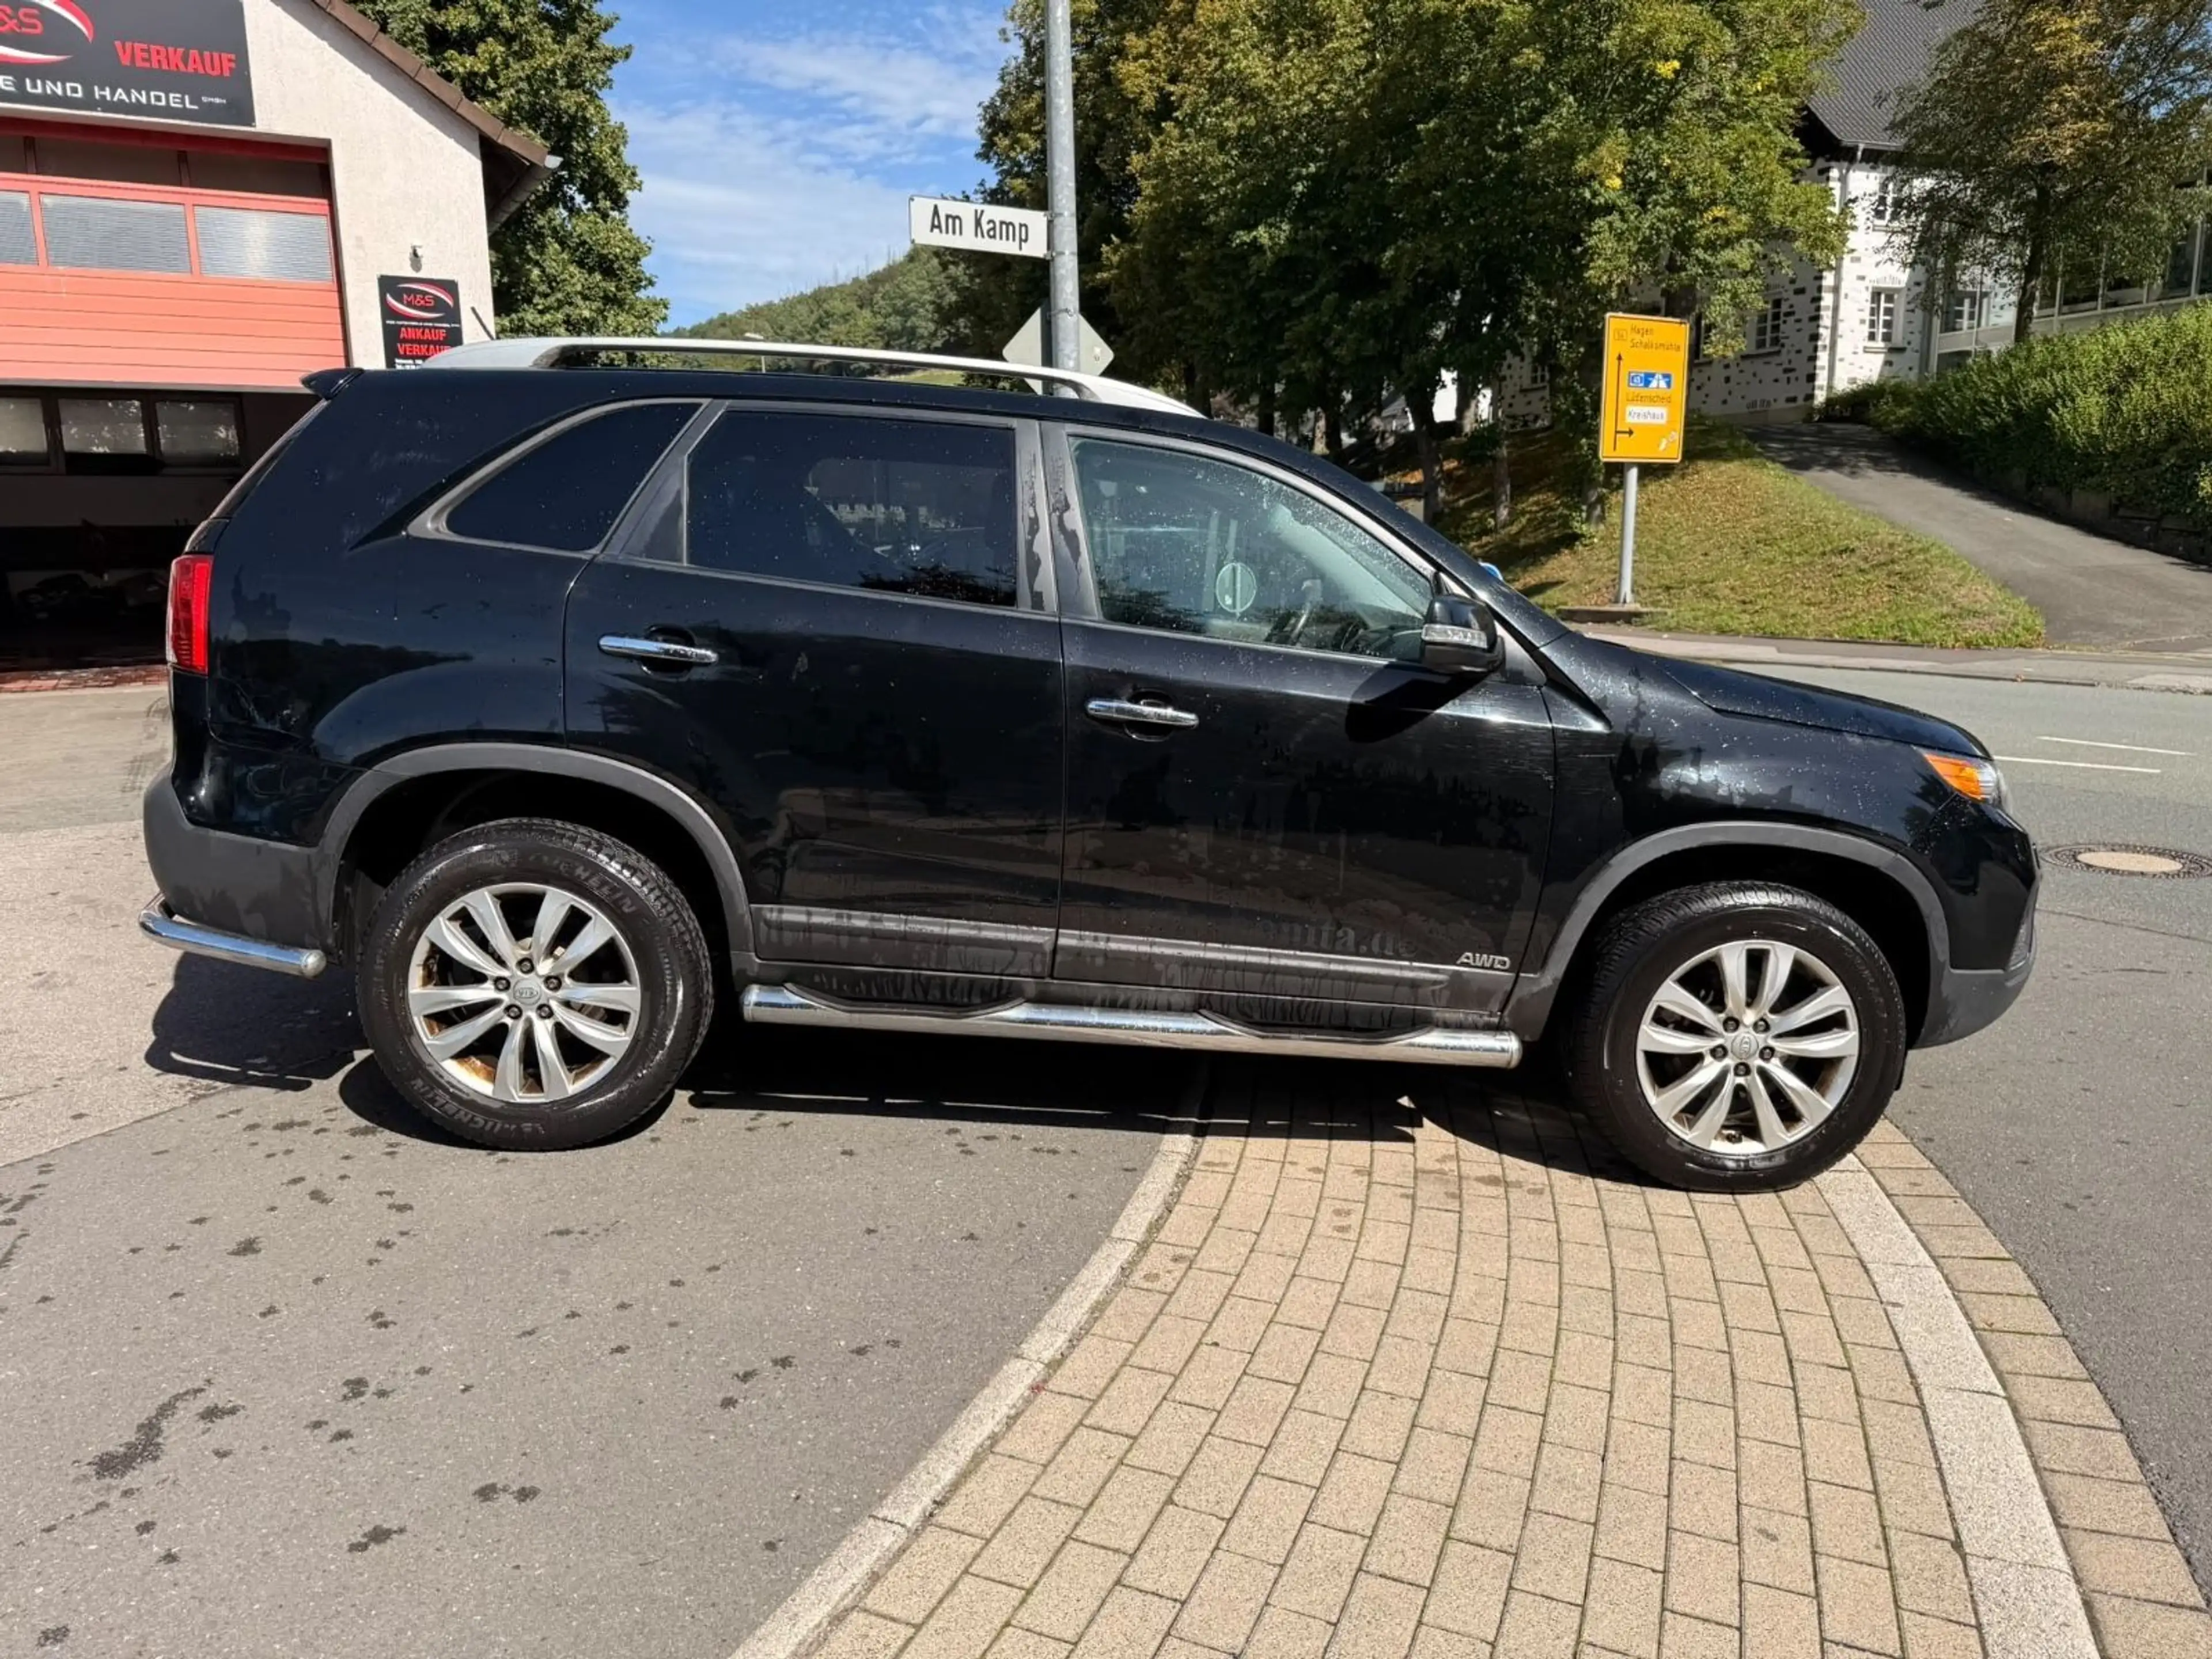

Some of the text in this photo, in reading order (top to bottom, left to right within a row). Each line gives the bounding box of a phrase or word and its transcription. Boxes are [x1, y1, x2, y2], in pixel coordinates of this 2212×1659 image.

[115, 40, 236, 77] VERKAUF
[0, 75, 17, 92] E
[25, 77, 83, 98] UND
[94, 85, 199, 109] HANDEL
[930, 203, 1029, 251] Am Kamp
[403, 293, 435, 307] M&S
[400, 327, 447, 340] ANKAUF
[396, 343, 452, 357] VERKAU
[528, 853, 638, 915] CHELIN
[1456, 952, 1511, 970] AWD
